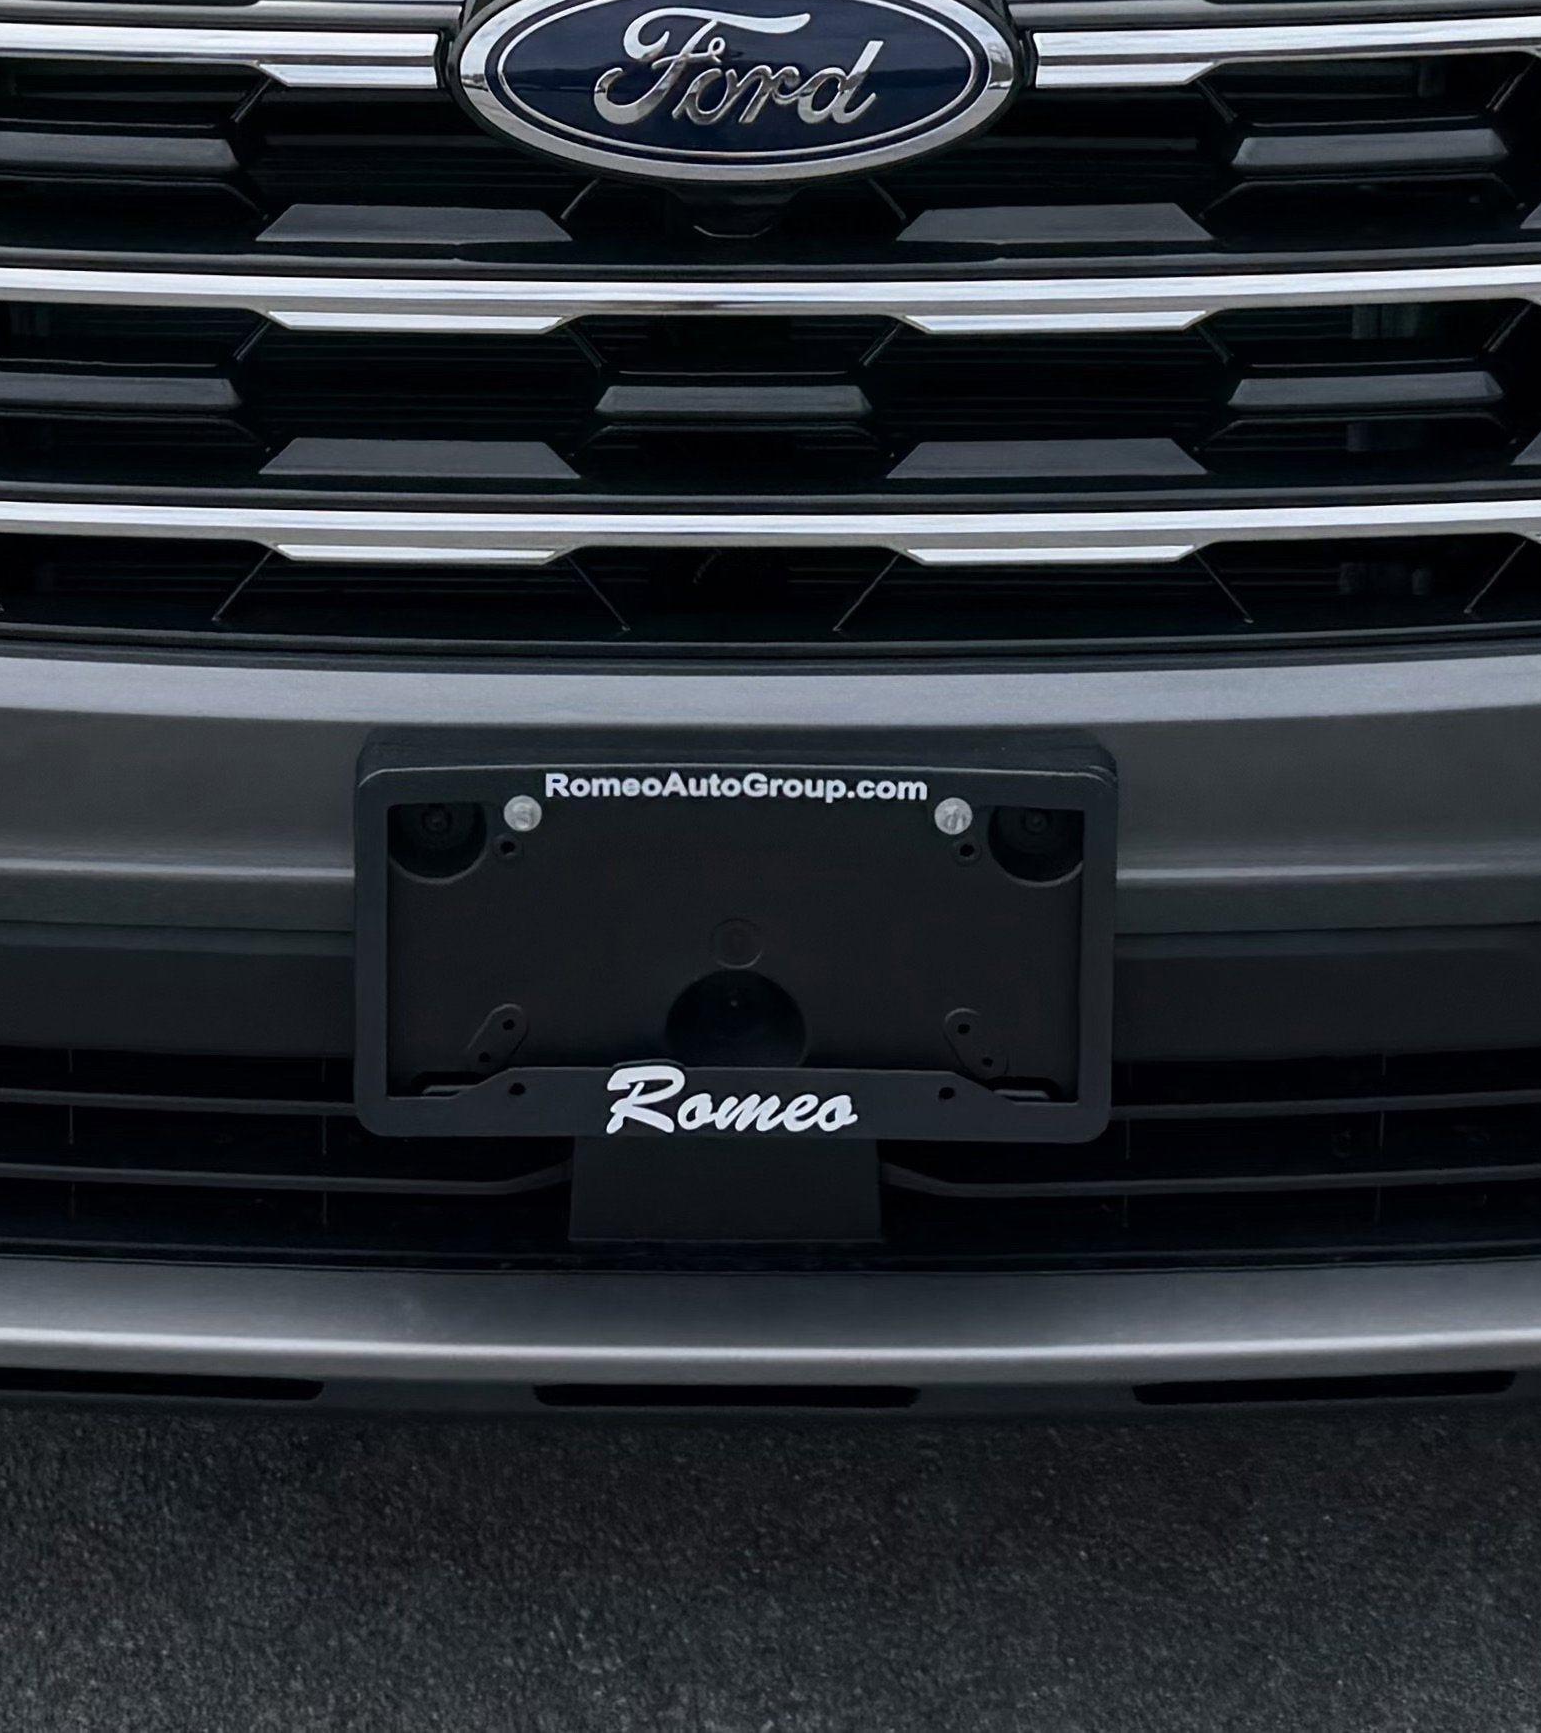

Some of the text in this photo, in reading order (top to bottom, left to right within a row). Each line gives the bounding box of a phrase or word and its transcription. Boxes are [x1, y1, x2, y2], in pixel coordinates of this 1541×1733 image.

[593, 7, 884, 125] Ford
[545, 771, 928, 803] RomeoAutoGroup.com
[606, 1065, 858, 1134] Romeo
